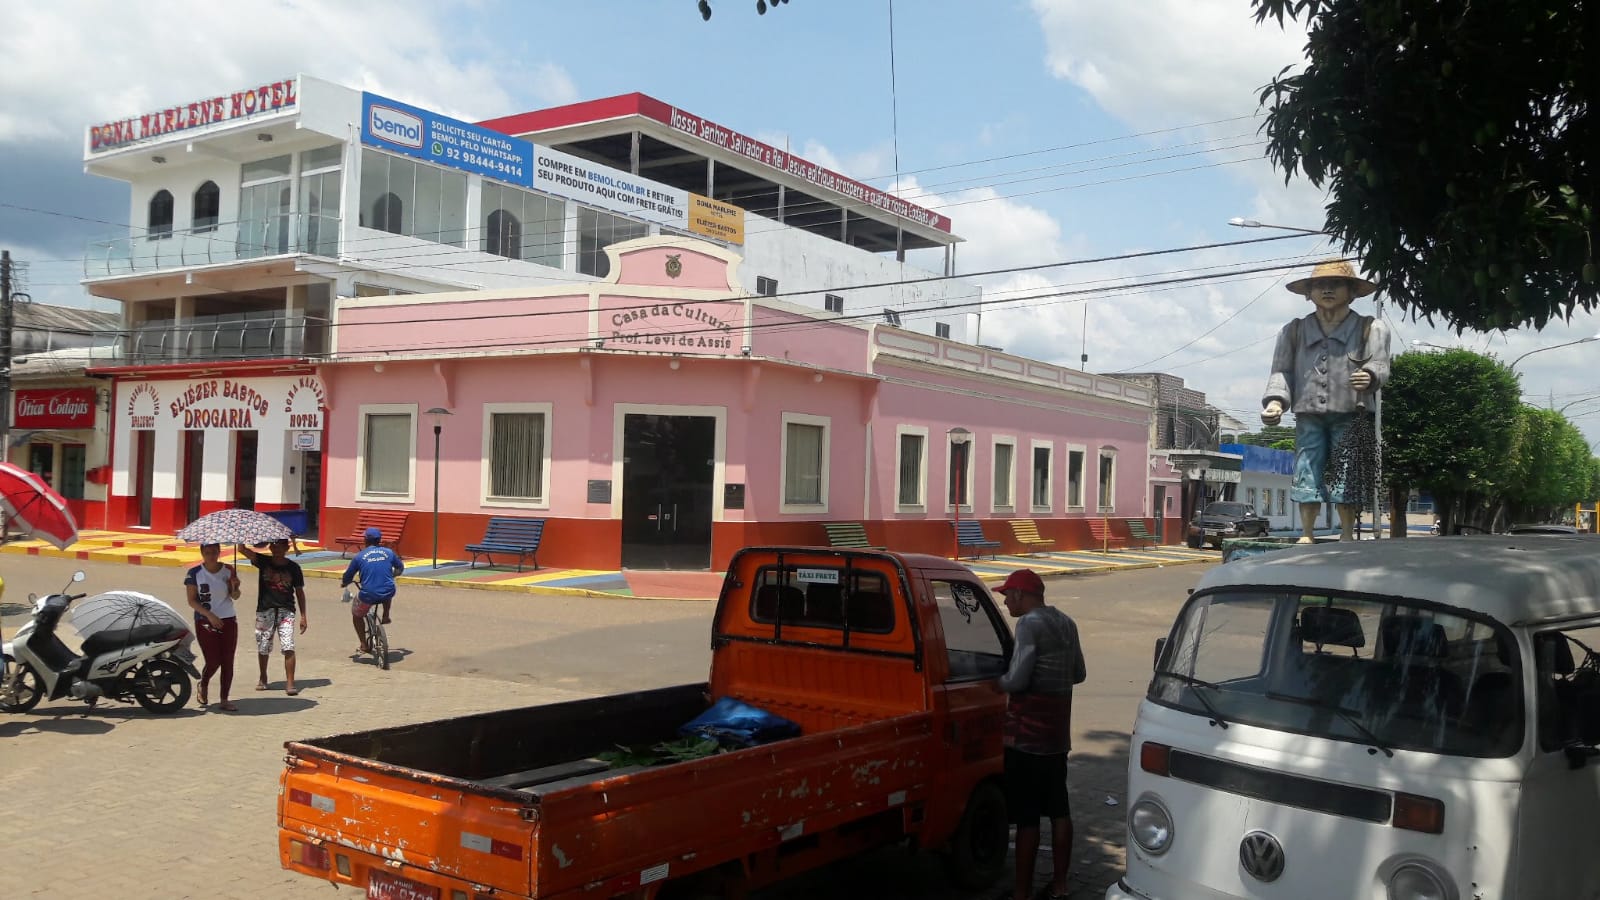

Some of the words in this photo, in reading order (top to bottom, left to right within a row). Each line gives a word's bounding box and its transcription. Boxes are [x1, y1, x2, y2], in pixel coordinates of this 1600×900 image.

[90, 119, 134, 149] DONA
[140, 97, 225, 137] MARLENE
[231, 80, 296, 118] HOTEL
[373, 112, 420, 141] bemol
[431, 120, 466, 138] SOLICITE
[466, 131, 481, 142] SEU
[482, 136, 512, 151] CARTÃO
[431, 131, 459, 146] BEMOL
[460, 140, 479, 151] PELO
[446, 147, 460, 160] 92
[462, 152, 522, 177] 98444-9414
[670, 106, 697, 136] Nosso
[731, 132, 764, 161] Salvador
[765, 150, 771, 163] e
[772, 149, 784, 169] Rei
[891, 199, 907, 216] nossa
[537, 155, 574, 174] COMPRE
[574, 165, 587, 178] EM
[587, 171, 645, 196] BEMOL.COM.BR
[646, 188, 651, 198] E
[652, 190, 675, 205] RETIRE
[537, 168, 554, 181] SEU
[555, 174, 595, 194] PRODUTO
[596, 185, 616, 199] AQUI
[616, 191, 635, 204] COM
[635, 197, 656, 210] FRETE
[612, 308, 648, 326] Casa
[651, 304, 669, 317] da
[612, 331, 641, 345] Prof.
[645, 333, 676, 346] Levi
[678, 335, 694, 347] de
[697, 335, 732, 349] Assis
[18, 395, 45, 417] Ótica
[48, 396, 89, 420] Codajás
[169, 379, 218, 418] ELIÉZER
[222, 379, 270, 417] BASTOS
[284, 384, 298, 412] DONA
[183, 408, 253, 428] DROGARIA
[289, 413, 319, 428] HOTEL
[815, 572, 837, 580] FRETE
